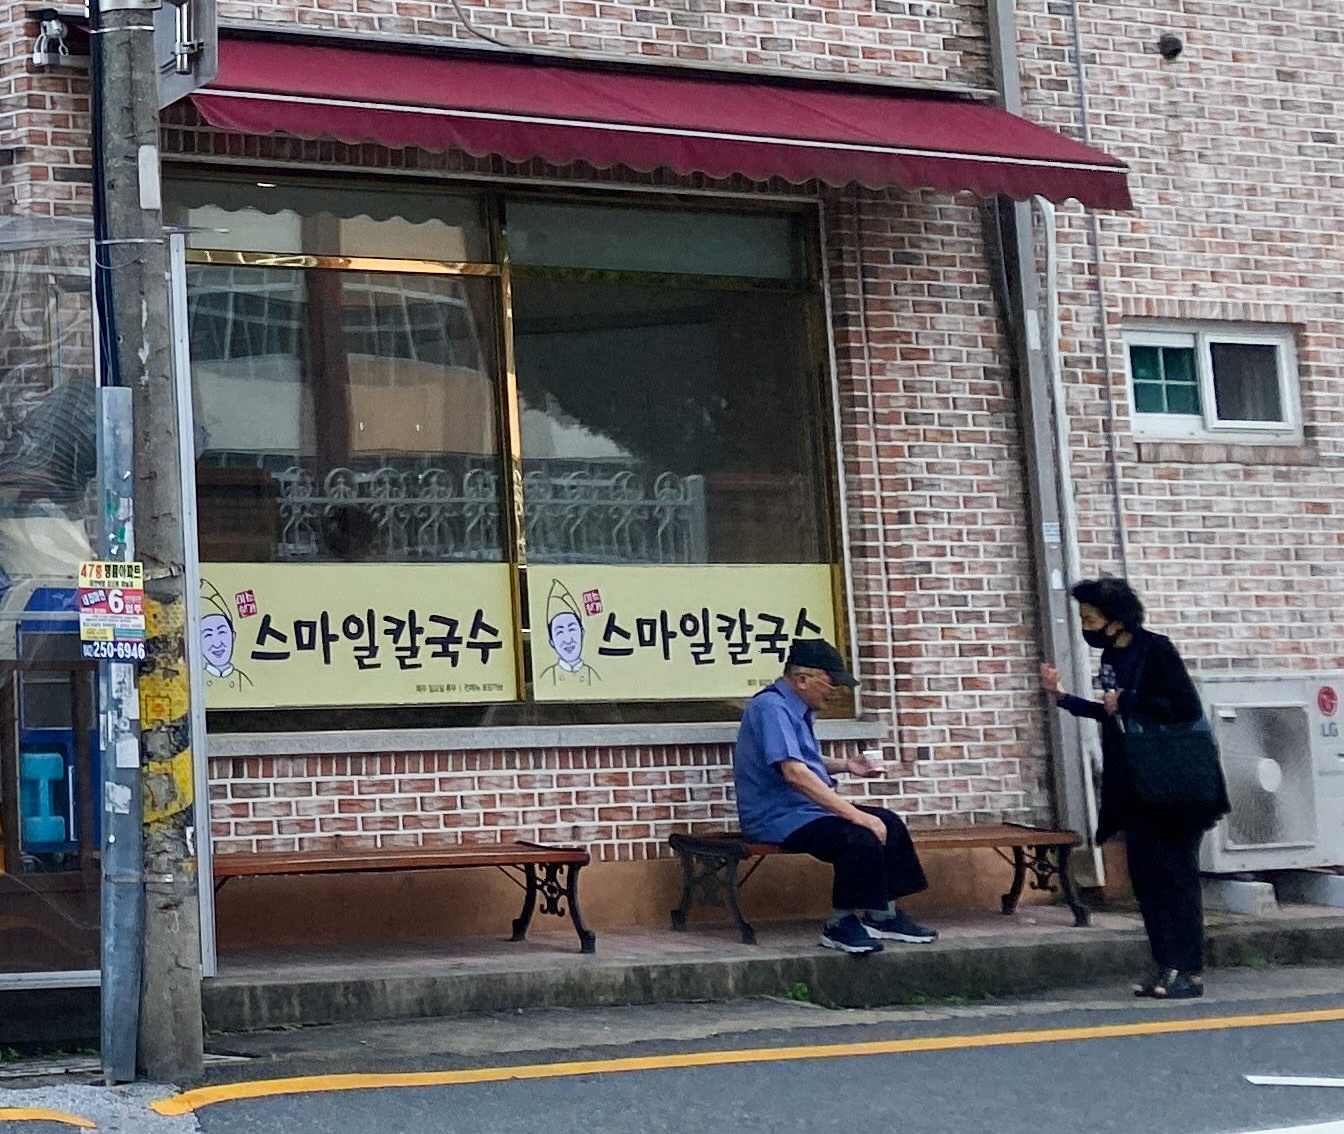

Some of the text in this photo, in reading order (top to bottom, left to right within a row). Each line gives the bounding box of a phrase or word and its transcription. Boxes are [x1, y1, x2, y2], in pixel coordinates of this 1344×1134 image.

[108, 589, 125, 614] 6
[93, 641, 146, 660] 250-6946
[251, 609, 503, 670] 스마일칼국수
[1321, 722, 1339, 737] LG
